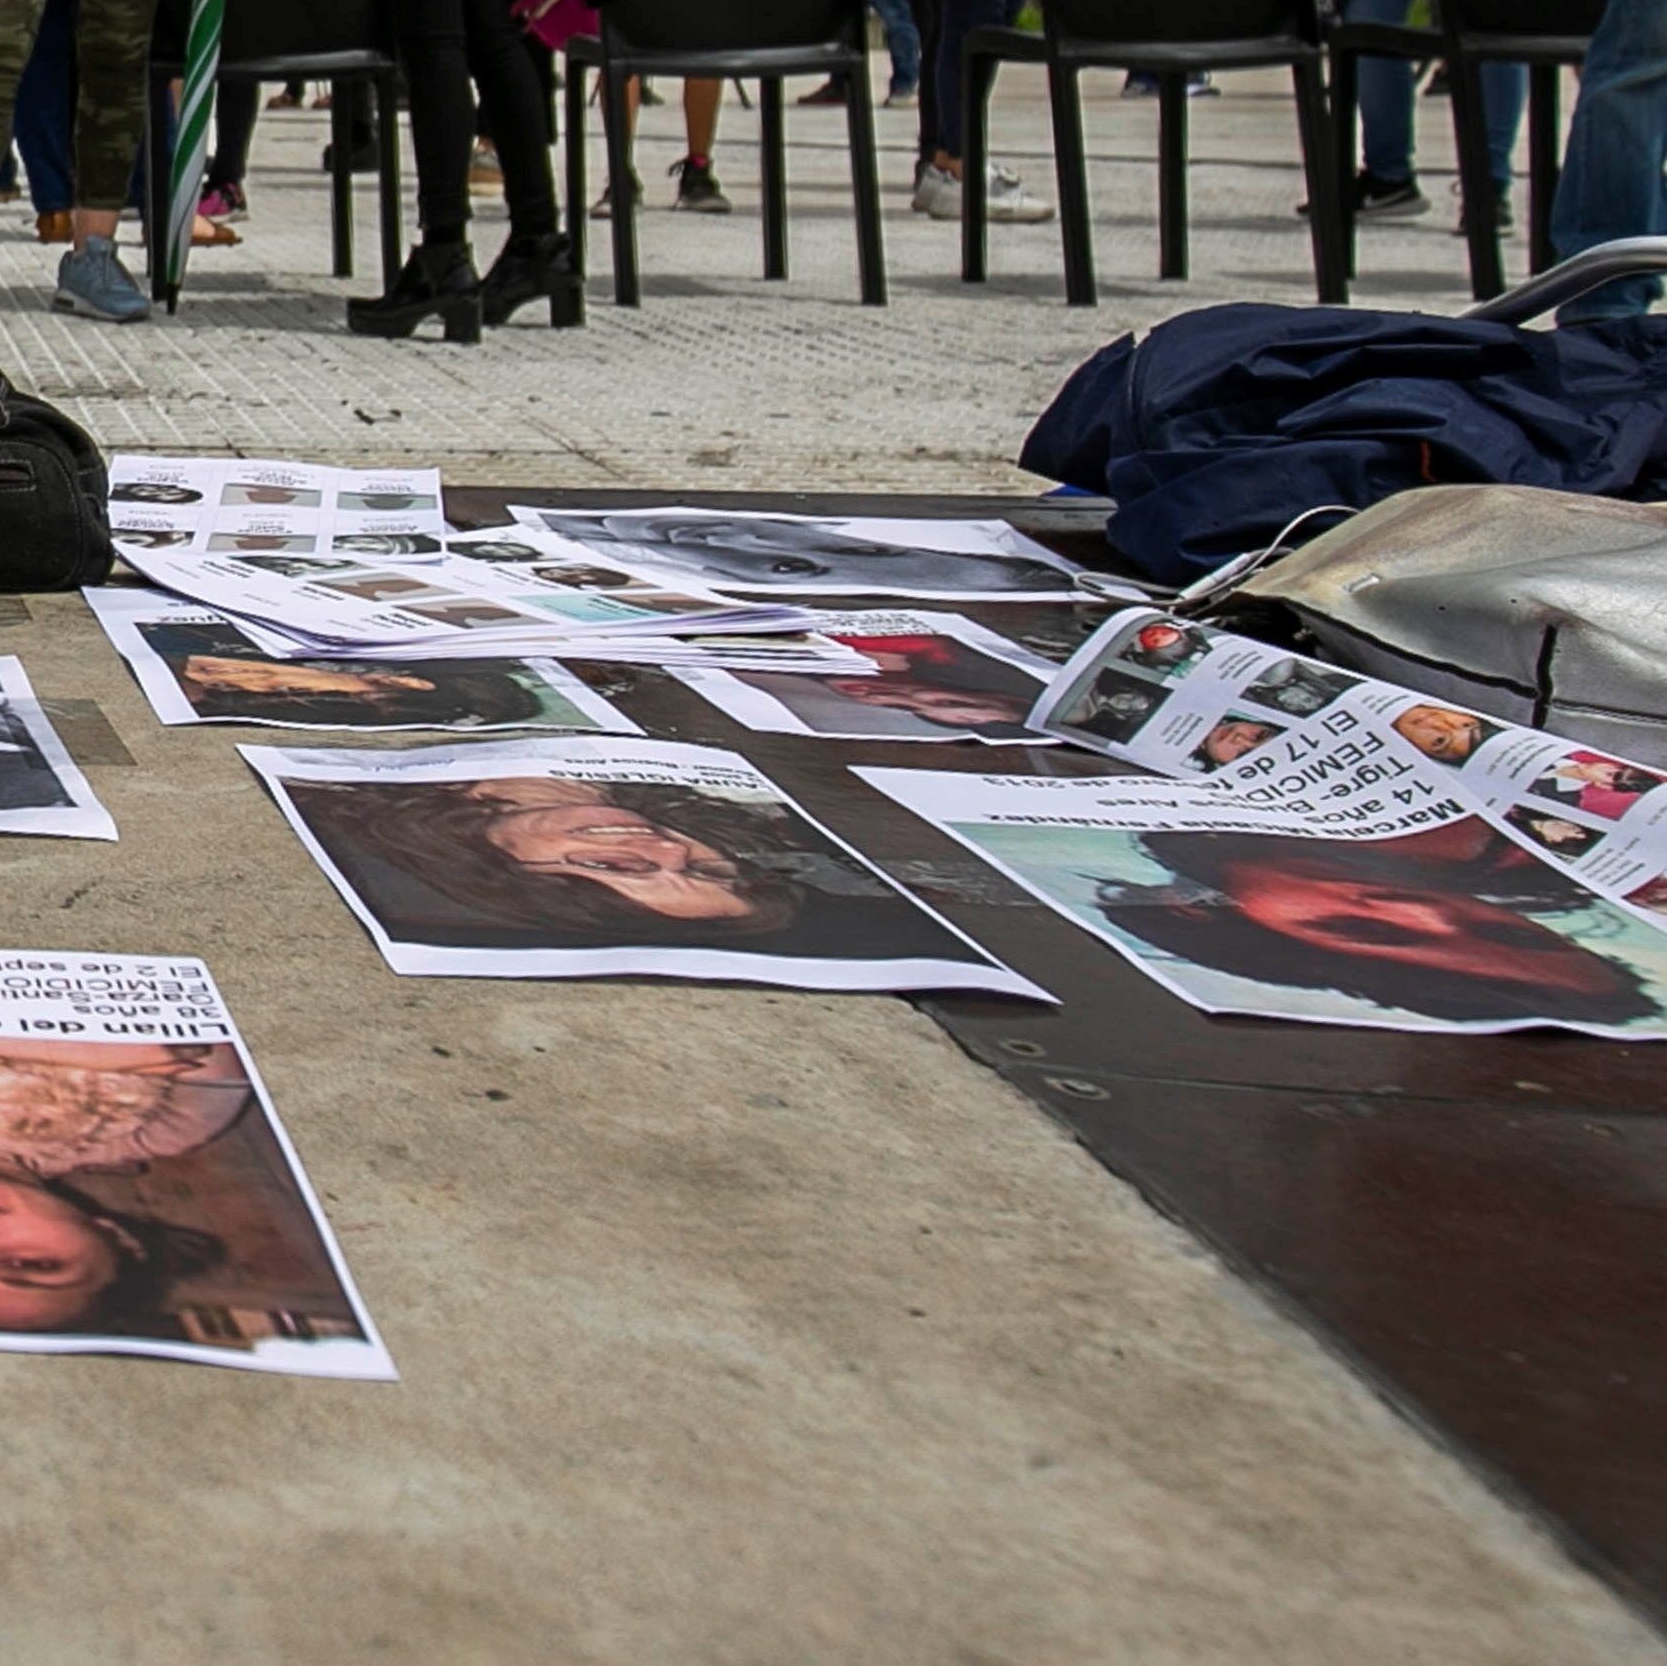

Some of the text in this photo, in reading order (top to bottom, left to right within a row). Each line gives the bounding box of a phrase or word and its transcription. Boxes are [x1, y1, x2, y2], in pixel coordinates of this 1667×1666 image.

[1318, 710, 1360, 734] El
[1282, 730, 1323, 758] 17
[548, 769, 676, 783] IGLESIAS
[1233, 756, 1277, 781] de
[1095, 798, 1179, 809] Aires
[1188, 798, 1311, 814] Buenos
[1303, 777, 1437, 826] 14 años
[1322, 799, 1467, 839] Marcela
[1180, 819, 1315, 836] Micaela
[80, 961, 123, 975] de
[135, 964, 157, 977] 2
[169, 964, 201, 978] El
[2, 977, 209, 992] FEMICIDIO
[72, 1005, 221, 1019] 38 años
[18, 1017, 86, 1035] del
[104, 1021, 230, 1038] Lilian
